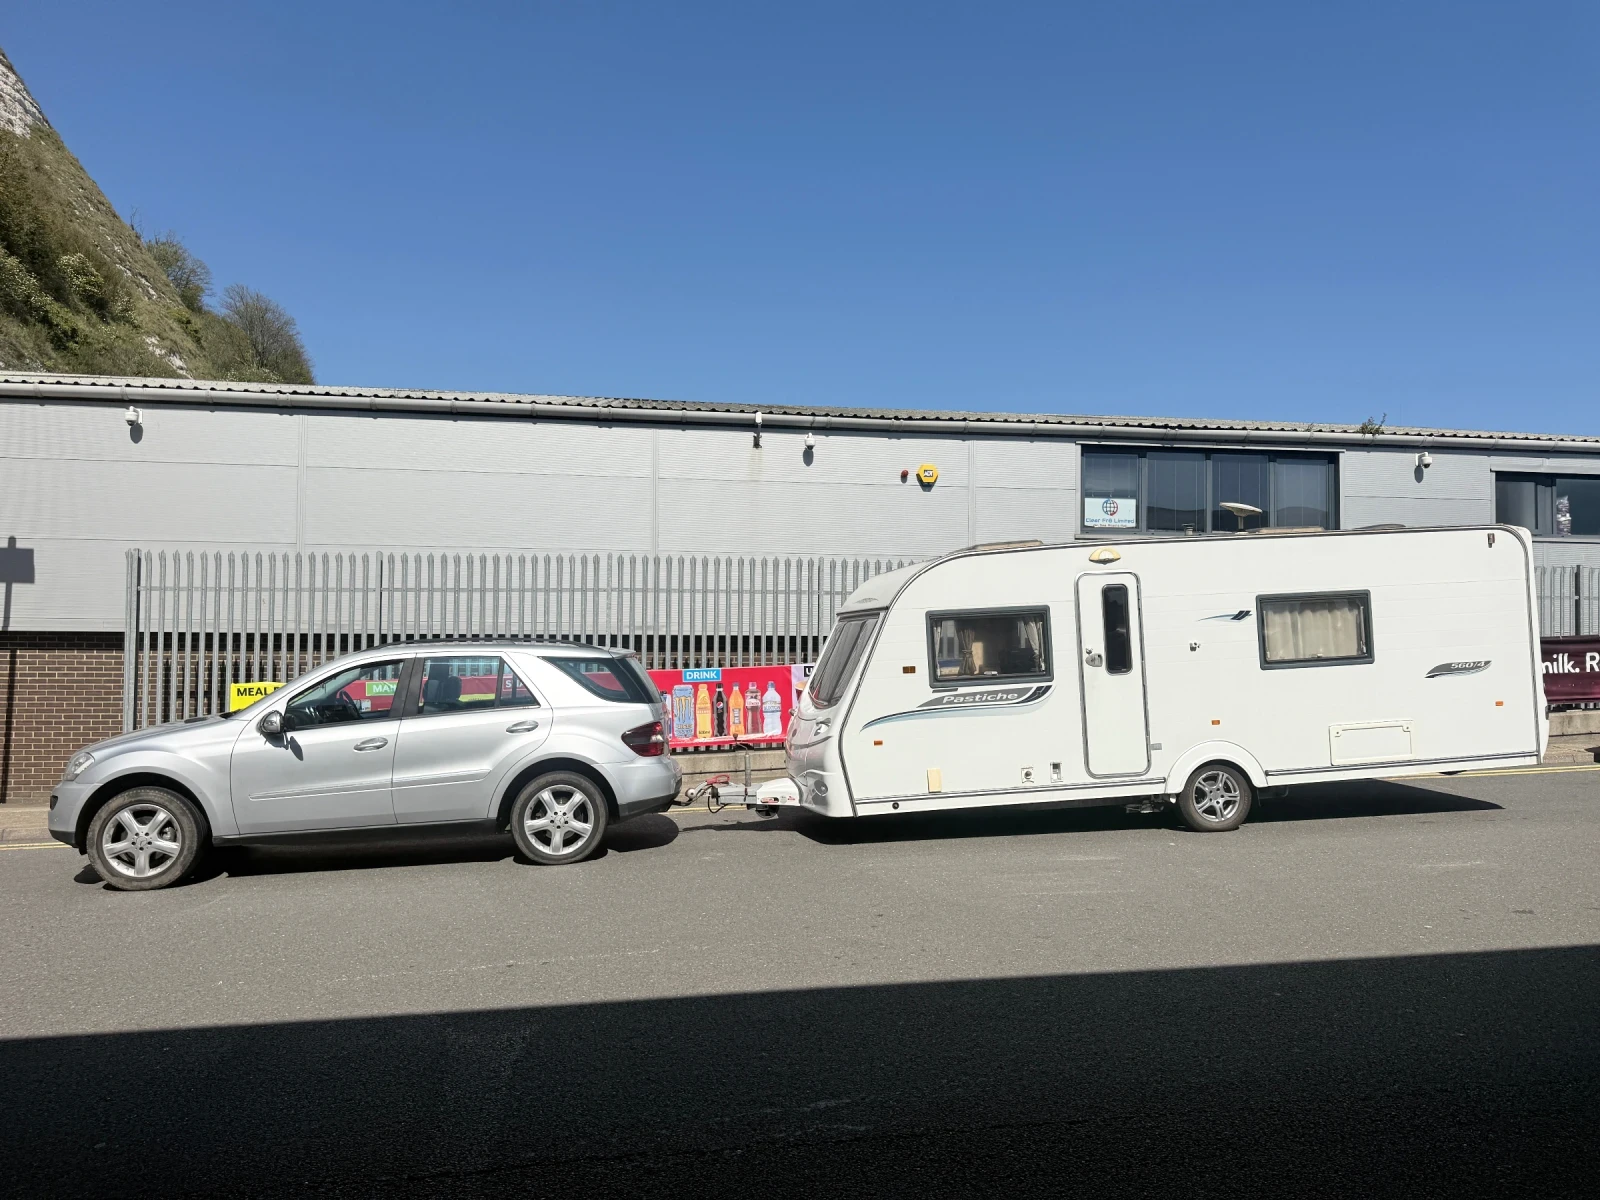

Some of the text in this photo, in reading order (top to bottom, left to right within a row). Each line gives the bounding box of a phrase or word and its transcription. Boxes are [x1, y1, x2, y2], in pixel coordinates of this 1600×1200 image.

[1450, 661, 1485, 669] 560/4
[686, 671, 718, 680] DRINK
[942, 693, 1018, 704] Pastiche
